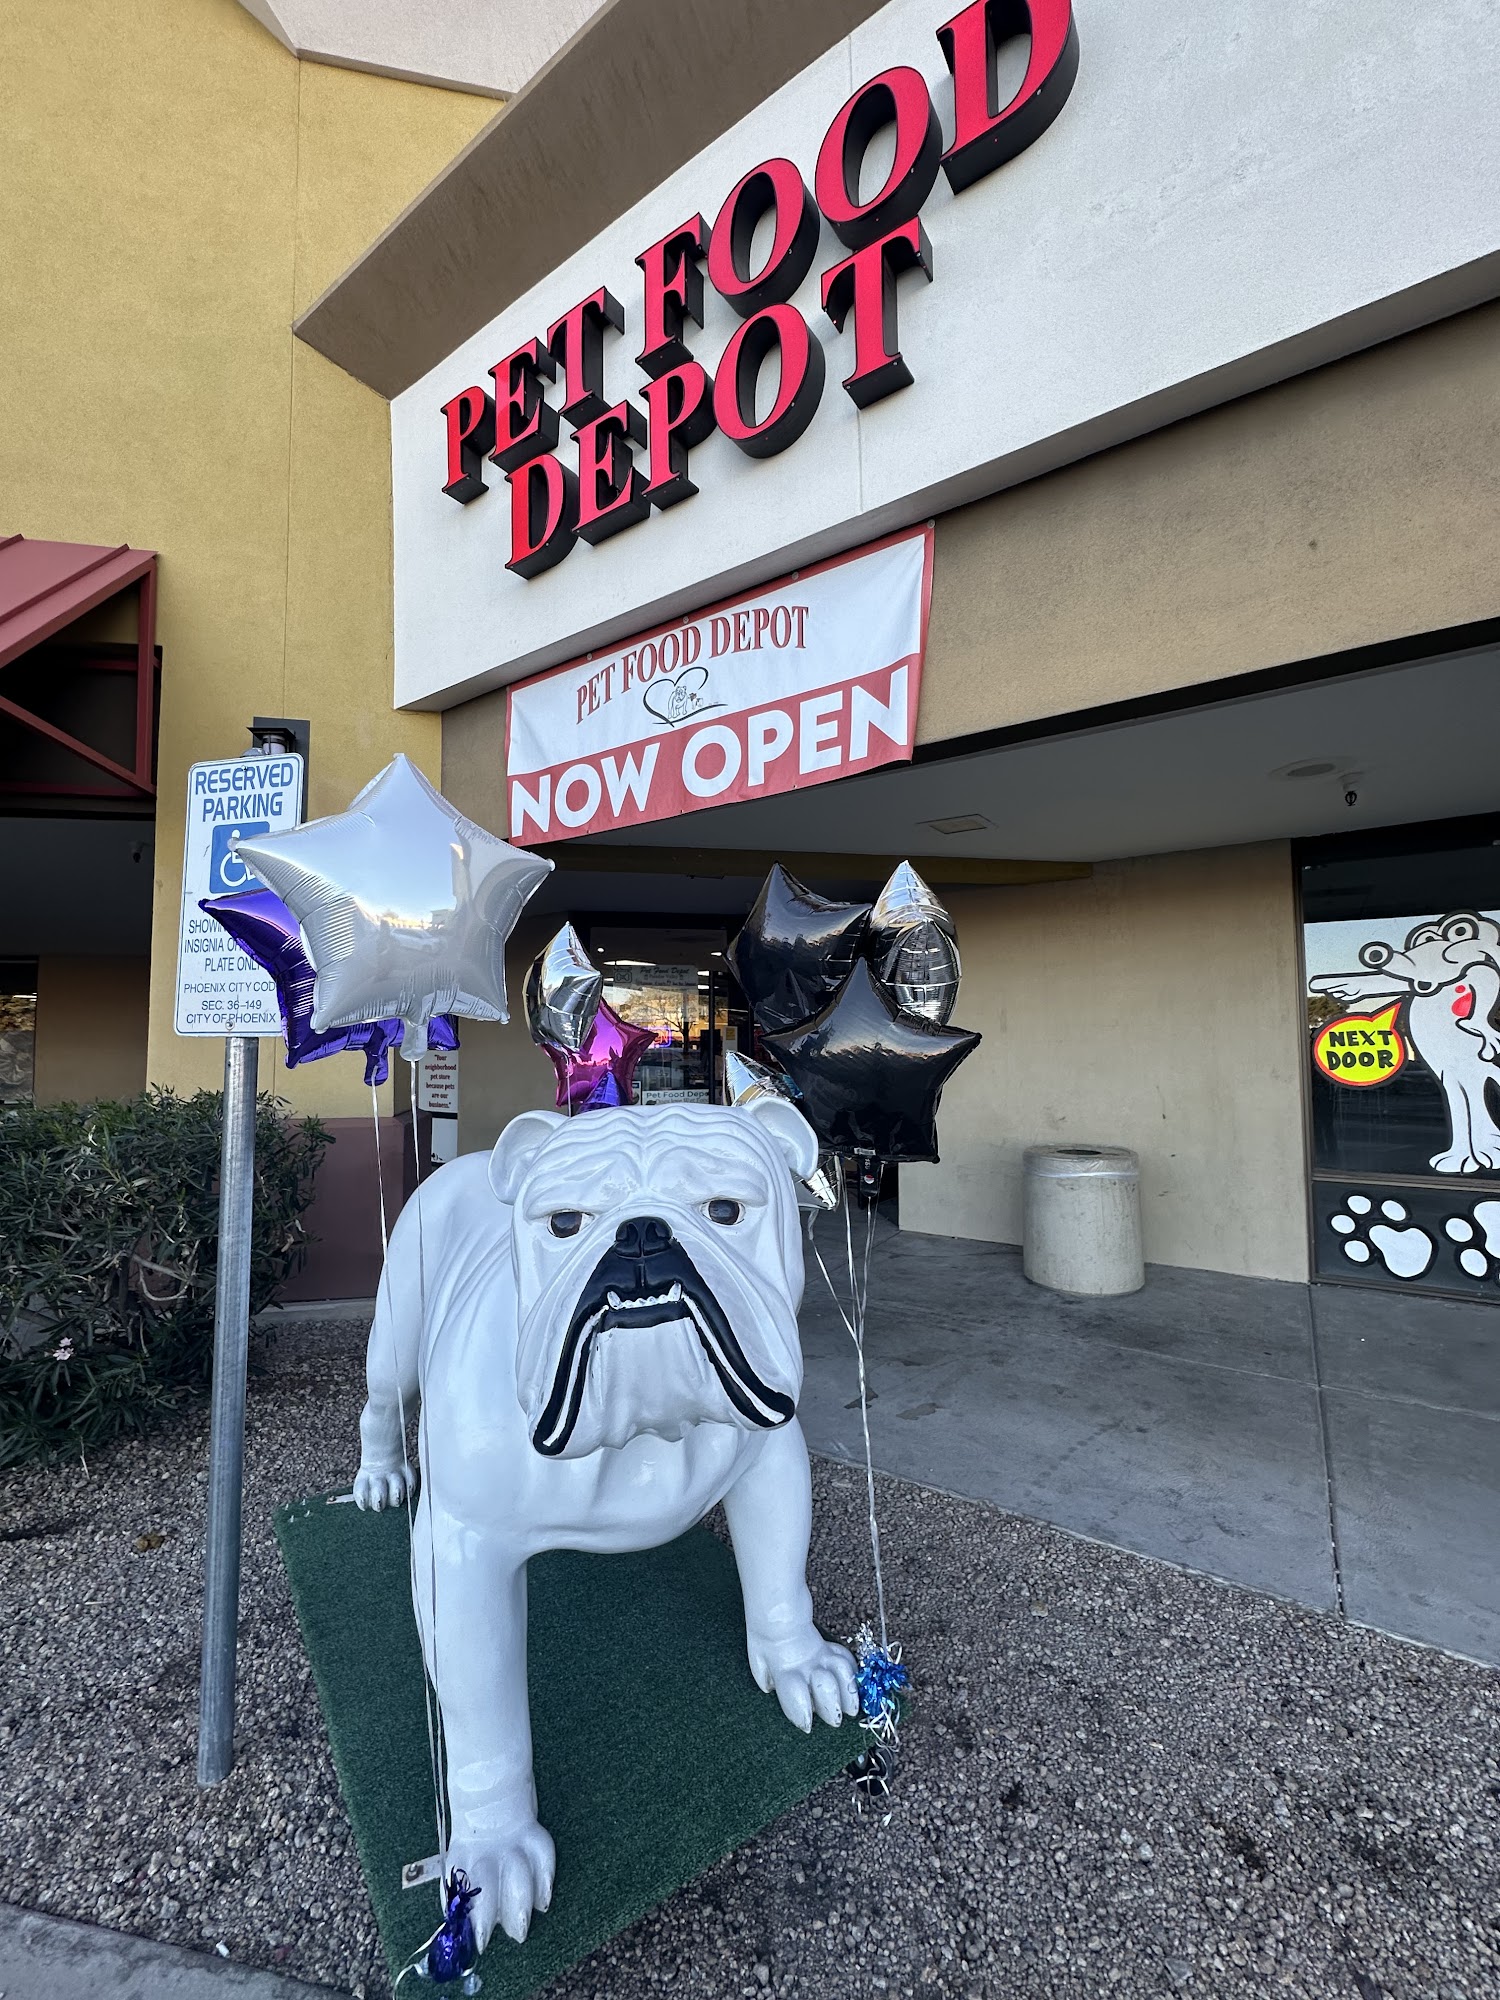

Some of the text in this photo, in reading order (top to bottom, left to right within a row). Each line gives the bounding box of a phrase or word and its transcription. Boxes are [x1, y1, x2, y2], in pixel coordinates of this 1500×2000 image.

[440, 0, 1077, 500] PET FOOD
[504, 216, 925, 573] DEPOT
[576, 605, 809, 725] PET FOOD DEPOT
[510, 664, 909, 838] NOW OPEN
[195, 762, 294, 796] RESERVED
[202, 791, 284, 823] PARKING
[184, 937, 225, 954] INSIGNIA
[204, 957, 235, 972] PLATE
[183, 981, 276, 994] PHOENIX CITY COD
[201, 999, 262, 1011] SEC. 36-149
[186, 1012, 277, 1024] CITY OF PHOENIX
[1328, 1029, 1393, 1048] NEXT
[1326, 1049, 1395, 1071] DOOR
[687, 1090, 709, 1099] Depo
